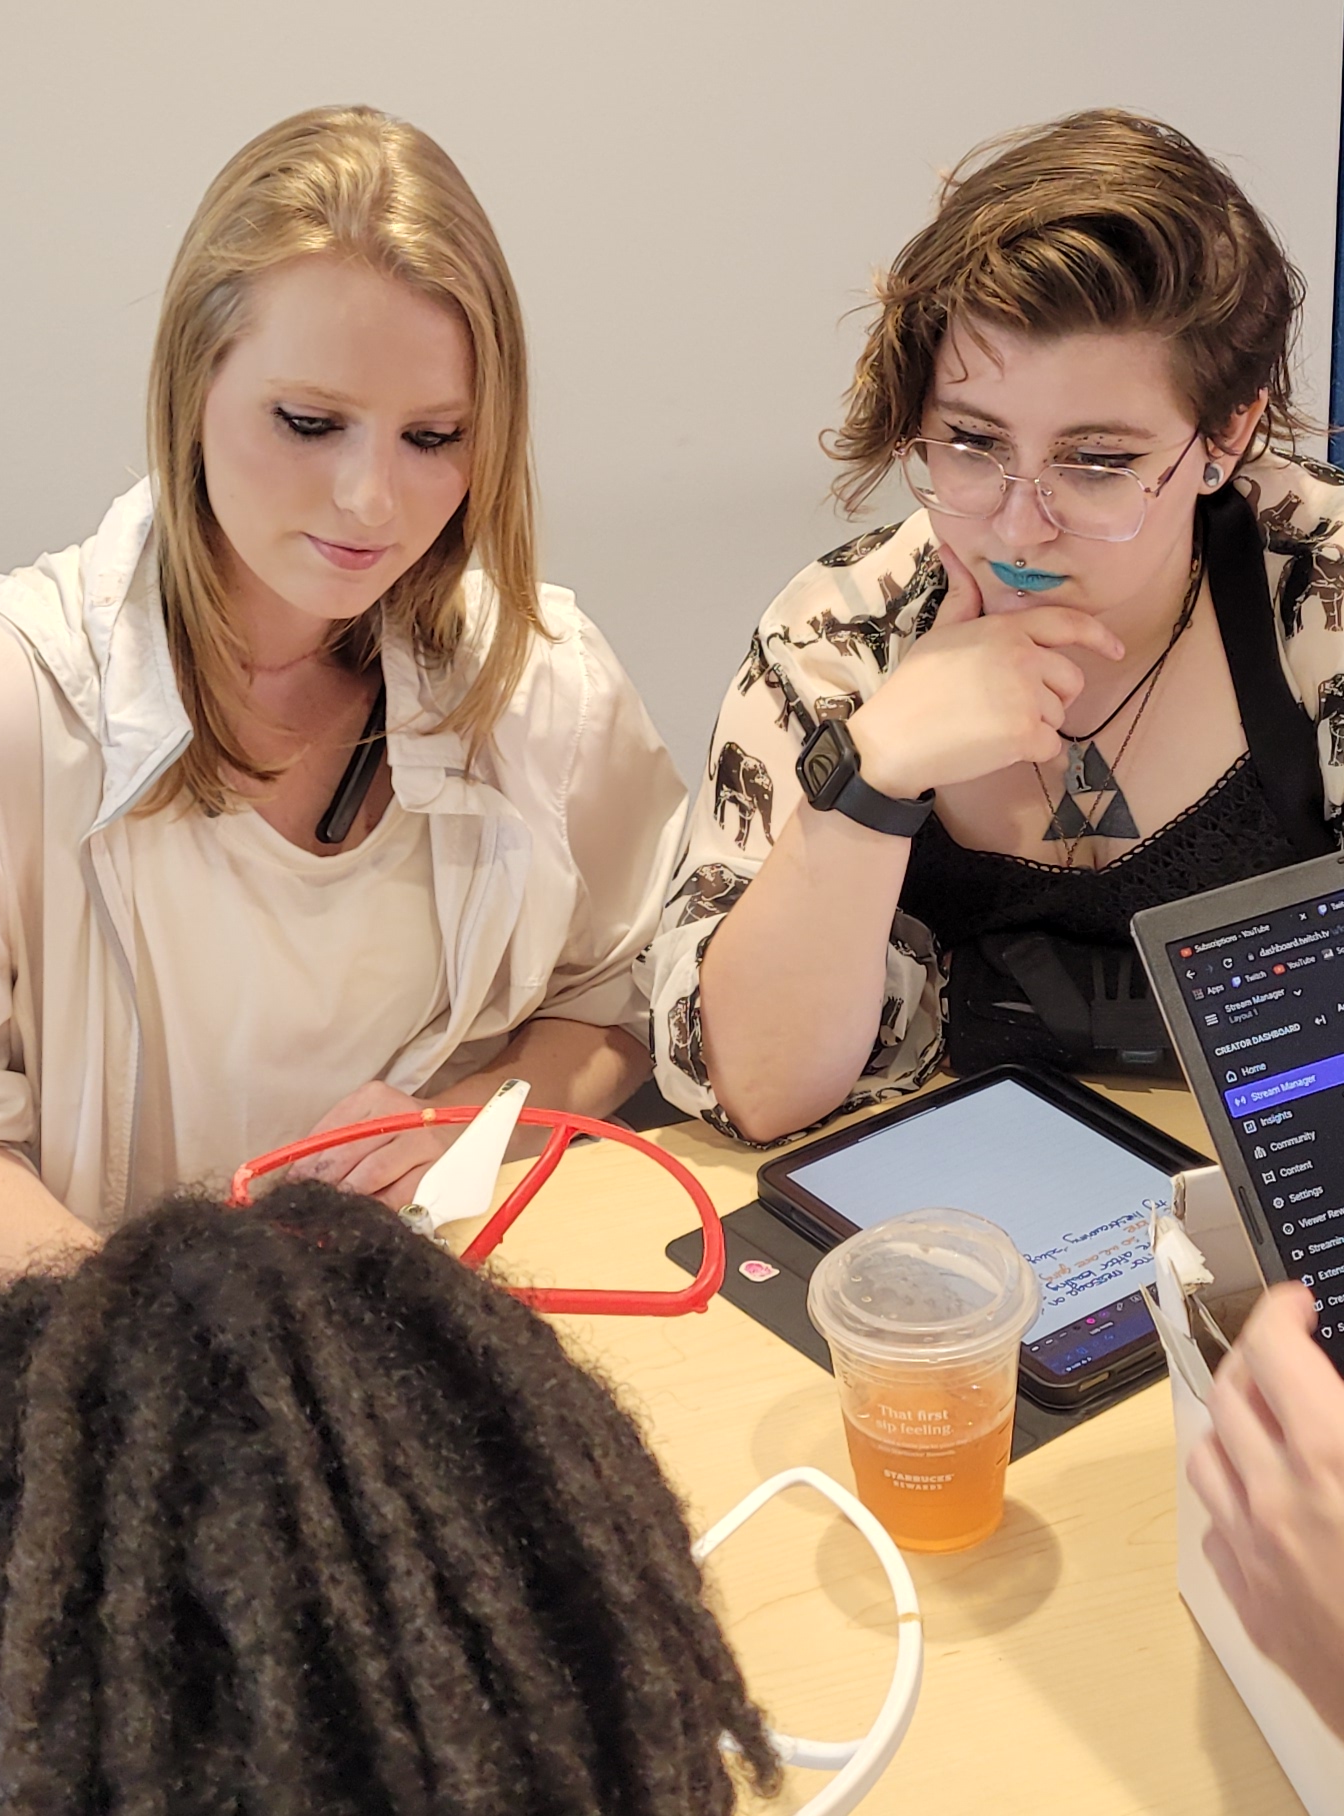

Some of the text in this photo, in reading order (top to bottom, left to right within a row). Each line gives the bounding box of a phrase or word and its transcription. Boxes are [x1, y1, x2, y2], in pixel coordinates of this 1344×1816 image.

[1194, 925, 1270, 952] Subscriptions YouTube
[1287, 957, 1315, 969] YouTube
[1245, 971, 1266, 982] Twitch
[1208, 985, 1224, 994] Apps
[1225, 989, 1284, 1012] Stream Manager
[1229, 1011, 1253, 1023] Layout
[1215, 1024, 1300, 1056] CREATOR DASHBOARD
[1241, 1063, 1266, 1076] Home
[1251, 1075, 1316, 1101] Stream Manager
[1260, 1111, 1292, 1126] Insights
[1270, 1131, 1315, 1151] Community
[1280, 1161, 1313, 1176] Content
[1289, 1186, 1323, 1202] Settings
[1298, 1214, 1326, 1228] Viewer
[878, 1404, 948, 1420] That first
[875, 1420, 954, 1436] sip feeling.
[883, 1469, 953, 1483] STARBUCKS
[892, 1480, 944, 1491] REWARDS
